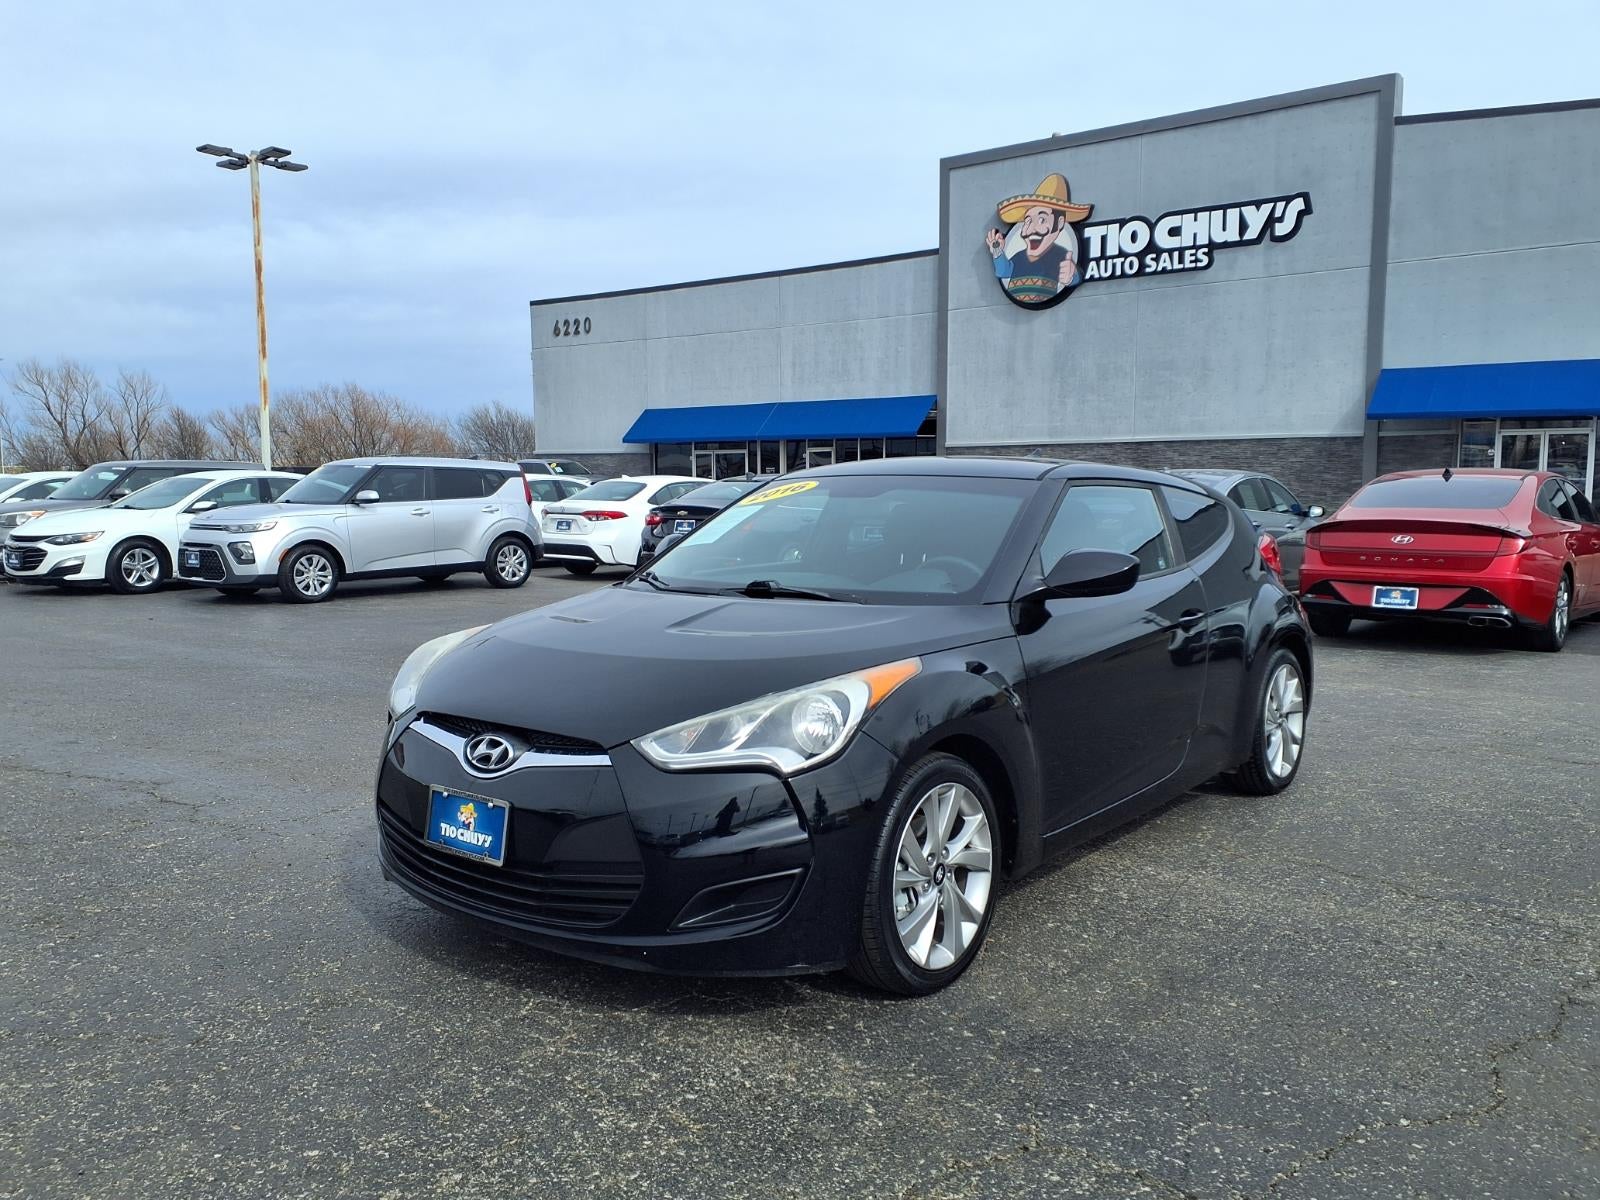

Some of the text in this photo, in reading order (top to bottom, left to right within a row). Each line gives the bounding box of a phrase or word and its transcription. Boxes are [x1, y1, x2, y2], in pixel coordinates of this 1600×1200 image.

[1084, 197, 1306, 260] TIO CHUY'S
[1085, 248, 1210, 279] AUTO SALES
[553, 316, 592, 337] 6220
[440, 822, 457, 838] TIO
